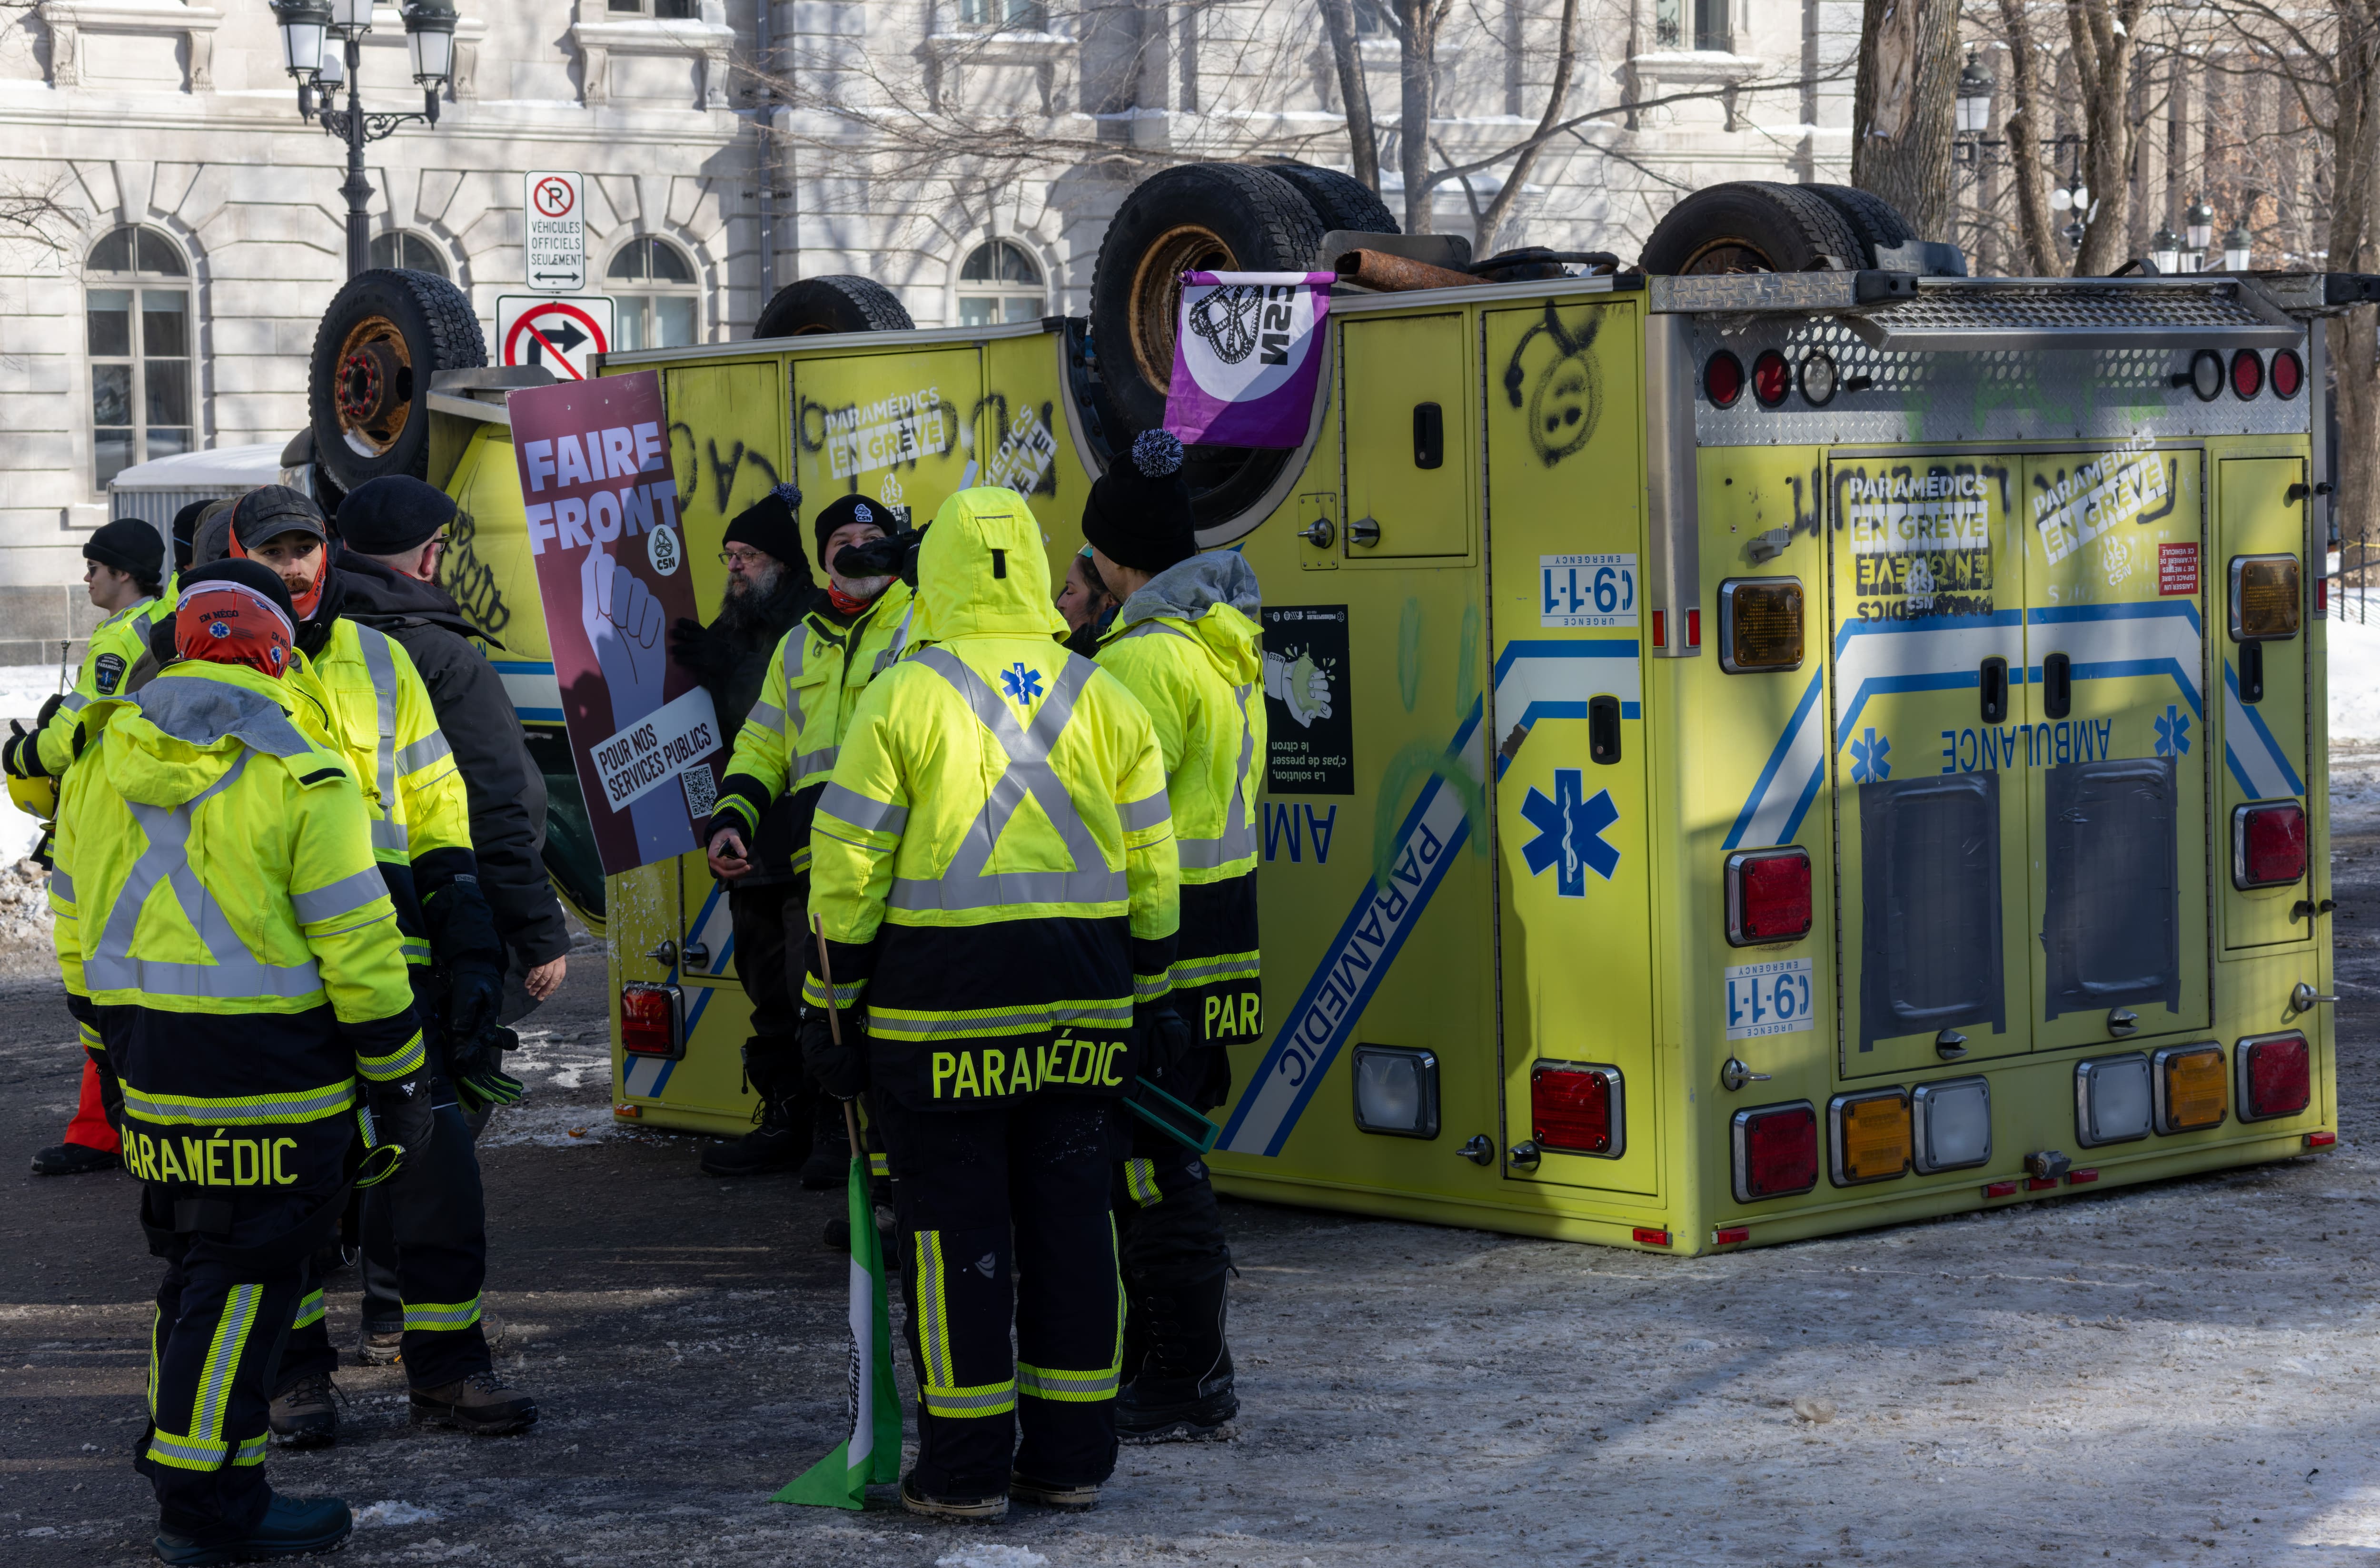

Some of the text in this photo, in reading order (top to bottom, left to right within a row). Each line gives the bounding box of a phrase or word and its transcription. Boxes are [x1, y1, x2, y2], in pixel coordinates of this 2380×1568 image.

[549, 187, 563, 207] P
[531, 219, 580, 234] VÉHICULES
[532, 237, 581, 249] OFFICIELS
[531, 254, 582, 266] SEULEMENT
[825, 386, 940, 434] PARAMÉDICS
[524, 421, 664, 492] FAIRE
[1849, 471, 1988, 499] PARAMÉDICS
[885, 503, 904, 515] SN
[525, 479, 678, 555] FRONT
[1897, 508, 1984, 541] GRÈVE
[656, 557, 676, 570] CSN
[1555, 555, 1621, 564] EMERGENCY
[2108, 564, 2132, 586] CSN
[1544, 567, 1617, 614] 9-1-1
[1906, 596, 1934, 610] CSN
[199, 609, 239, 623] EN NÉGO
[1564, 618, 1615, 626] URGENCE
[271, 631, 279, 642] EN
[1269, 652, 1285, 664] MSSS
[97, 662, 121, 671] PARAMEDIC
[598, 723, 657, 776] POUR NOS
[1271, 741, 1309, 753] le citron
[1941, 718, 2112, 773] AMBULANCE
[608, 722, 712, 802] SERVICES PUBLICS
[1272, 754, 1347, 768] c'pas de presser
[1272, 769, 1326, 782] La solution,
[1279, 821, 1442, 1087] PARAMEDIC
[1739, 961, 1798, 976] EMERGENCY
[1728, 973, 1795, 1026] 9-1-1
[1205, 993, 1263, 1040] PAR
[1747, 1023, 1793, 1036] URGENCE
[121, 1123, 298, 1186] PARAMÉDIC
